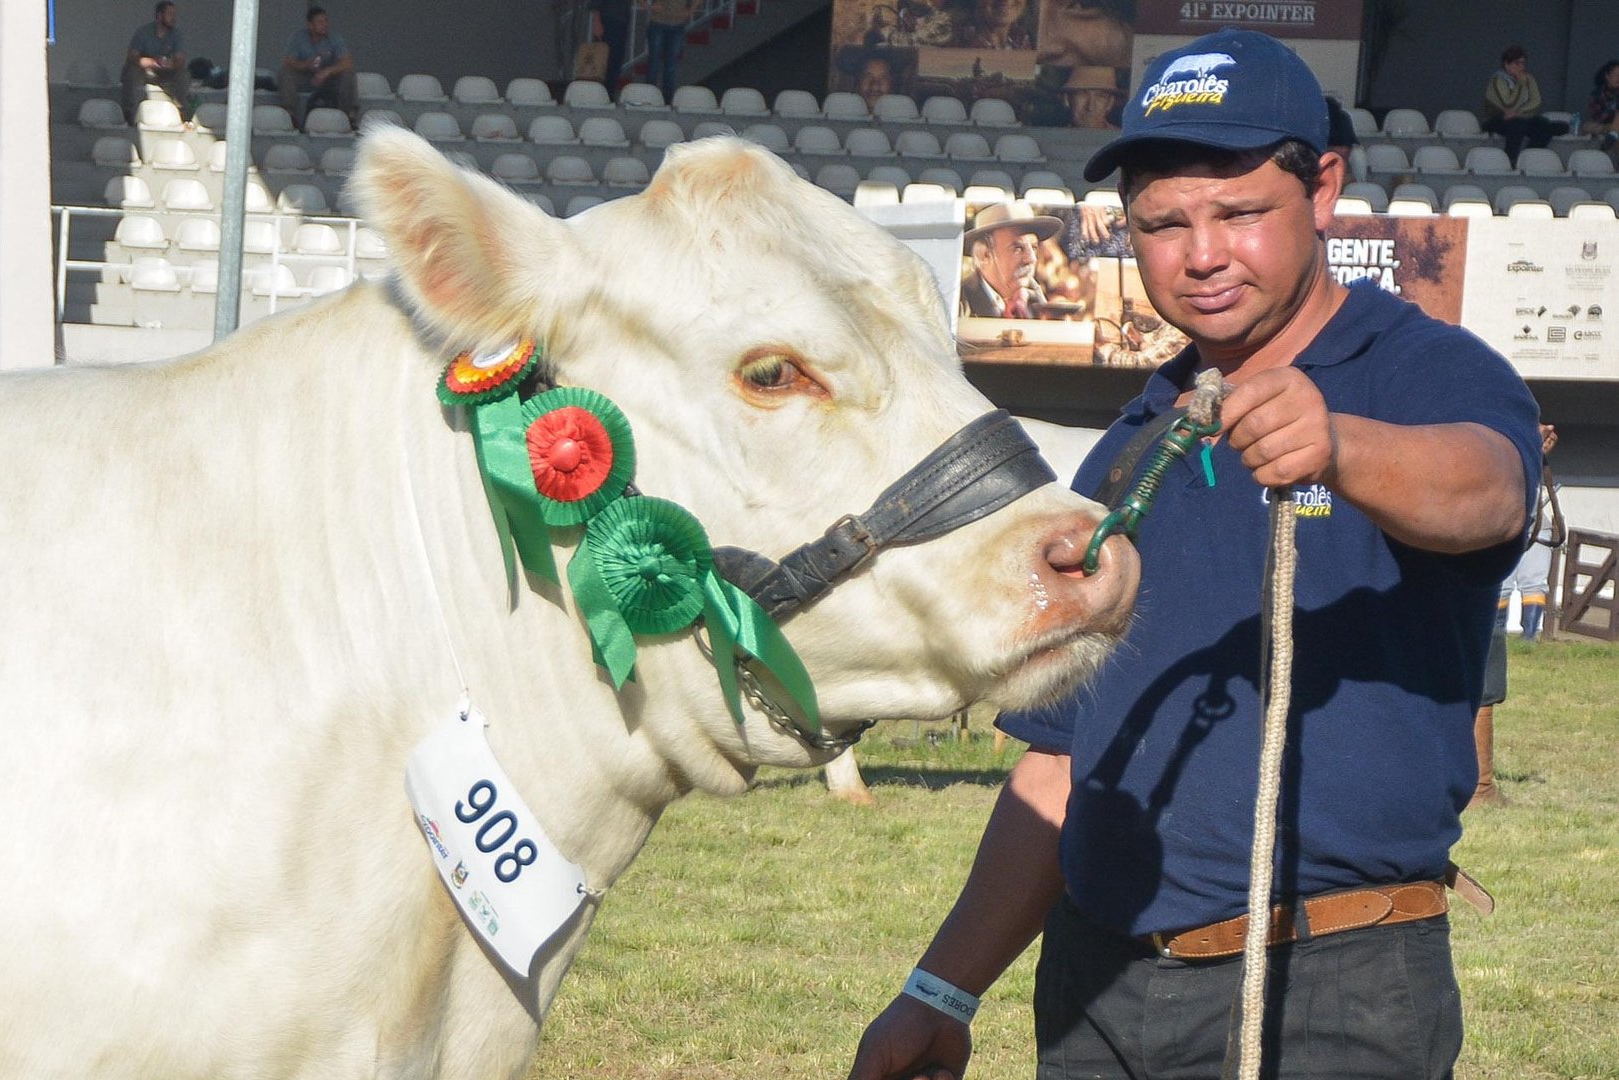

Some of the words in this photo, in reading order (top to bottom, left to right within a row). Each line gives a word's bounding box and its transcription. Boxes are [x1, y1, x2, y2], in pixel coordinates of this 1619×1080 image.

[1212, 4, 1315, 21] EXPOINTER
[1142, 74, 1229, 107] Charolês
[1327, 238, 1401, 269] GENTE,
[454, 778, 538, 884] 908
